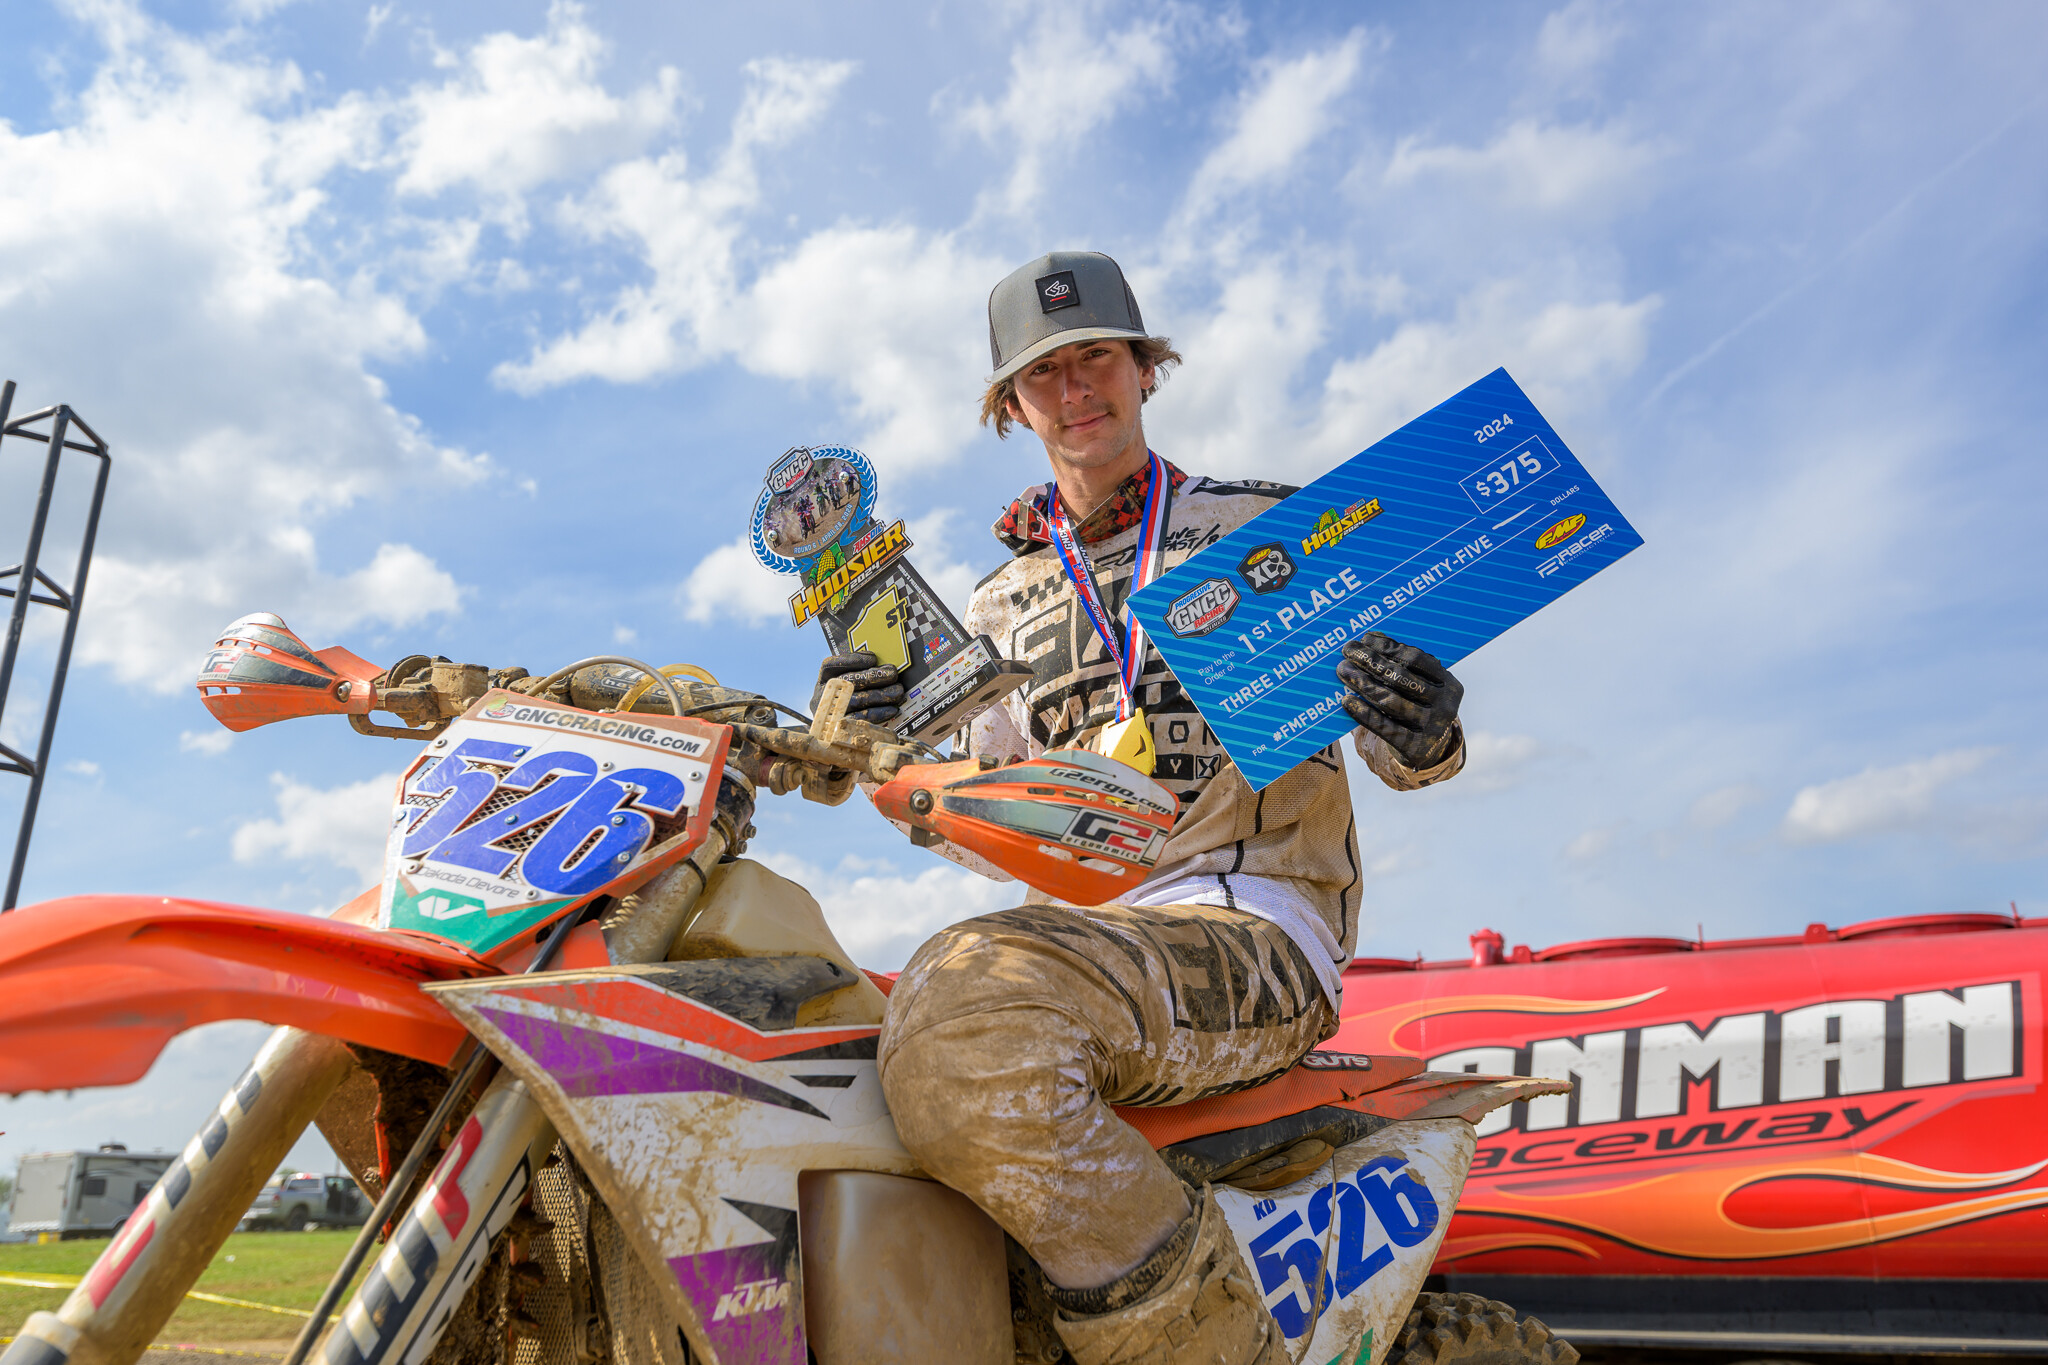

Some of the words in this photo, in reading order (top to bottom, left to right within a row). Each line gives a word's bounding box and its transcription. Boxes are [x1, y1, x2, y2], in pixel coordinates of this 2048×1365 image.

[1474, 413, 1513, 443] 2024
[773, 453, 809, 490] GNCC
[1476, 451, 1541, 497] $375
[1550, 484, 1580, 506] DOLLARS
[821, 530, 837, 544] APRIL
[853, 524, 883, 554] AMSOIL
[1166, 527, 1201, 541] IVE
[1301, 498, 1382, 556] HOOSIER
[1538, 513, 1585, 550] FMF
[1563, 531, 1615, 565] PRODUCTIONS
[791, 521, 905, 626] HOOSIER
[849, 561, 880, 589] 2024
[1072, 562, 1093, 589] AMA
[1089, 600, 1106, 625] GNCC
[1172, 583, 1231, 631] GNCC
[1175, 582, 1213, 610] PROGRESSIVE
[1276, 567, 1362, 631] PLACE
[1194, 604, 1225, 629] RACING
[1218, 674, 1274, 714] THREE
[1272, 626, 1348, 680] HUNDRED
[1350, 604, 1382, 634] AND
[1383, 534, 1494, 608] SEVENTY-FIVE
[924, 633, 950, 661] AMA
[1198, 662, 1212, 677] Pay
[1213, 656, 1222, 667] to
[1223, 650, 1236, 663] the
[836, 673, 854, 682] ACE
[1204, 668, 1226, 686] Order
[1226, 664, 1236, 675] of
[1362, 652, 1385, 672] RACE
[1384, 667, 1426, 694] DIVISION
[911, 711, 931, 730] 125
[933, 676, 978, 714] PRO-AM
[513, 705, 701, 754] GNCCRACING.COM
[1252, 743, 1268, 757] FOR
[1272, 685, 1357, 742] #FMFBRAAA
[1049, 767, 1175, 816] G2ergo.com
[400, 737, 686, 896] 526
[1070, 811, 1153, 854] G2
[1065, 836, 1139, 860] ergonomics
[417, 866, 466, 886] Dakoda
[465, 877, 520, 898] Devore
[1302, 1053, 1370, 1067] GUTS
[1428, 982, 2020, 1138] NMAN
[1470, 1100, 1923, 1170] aceway
[1252, 1198, 1278, 1221] KD
[1248, 1155, 1440, 1339] 526
[711, 1277, 794, 1322] KTM
